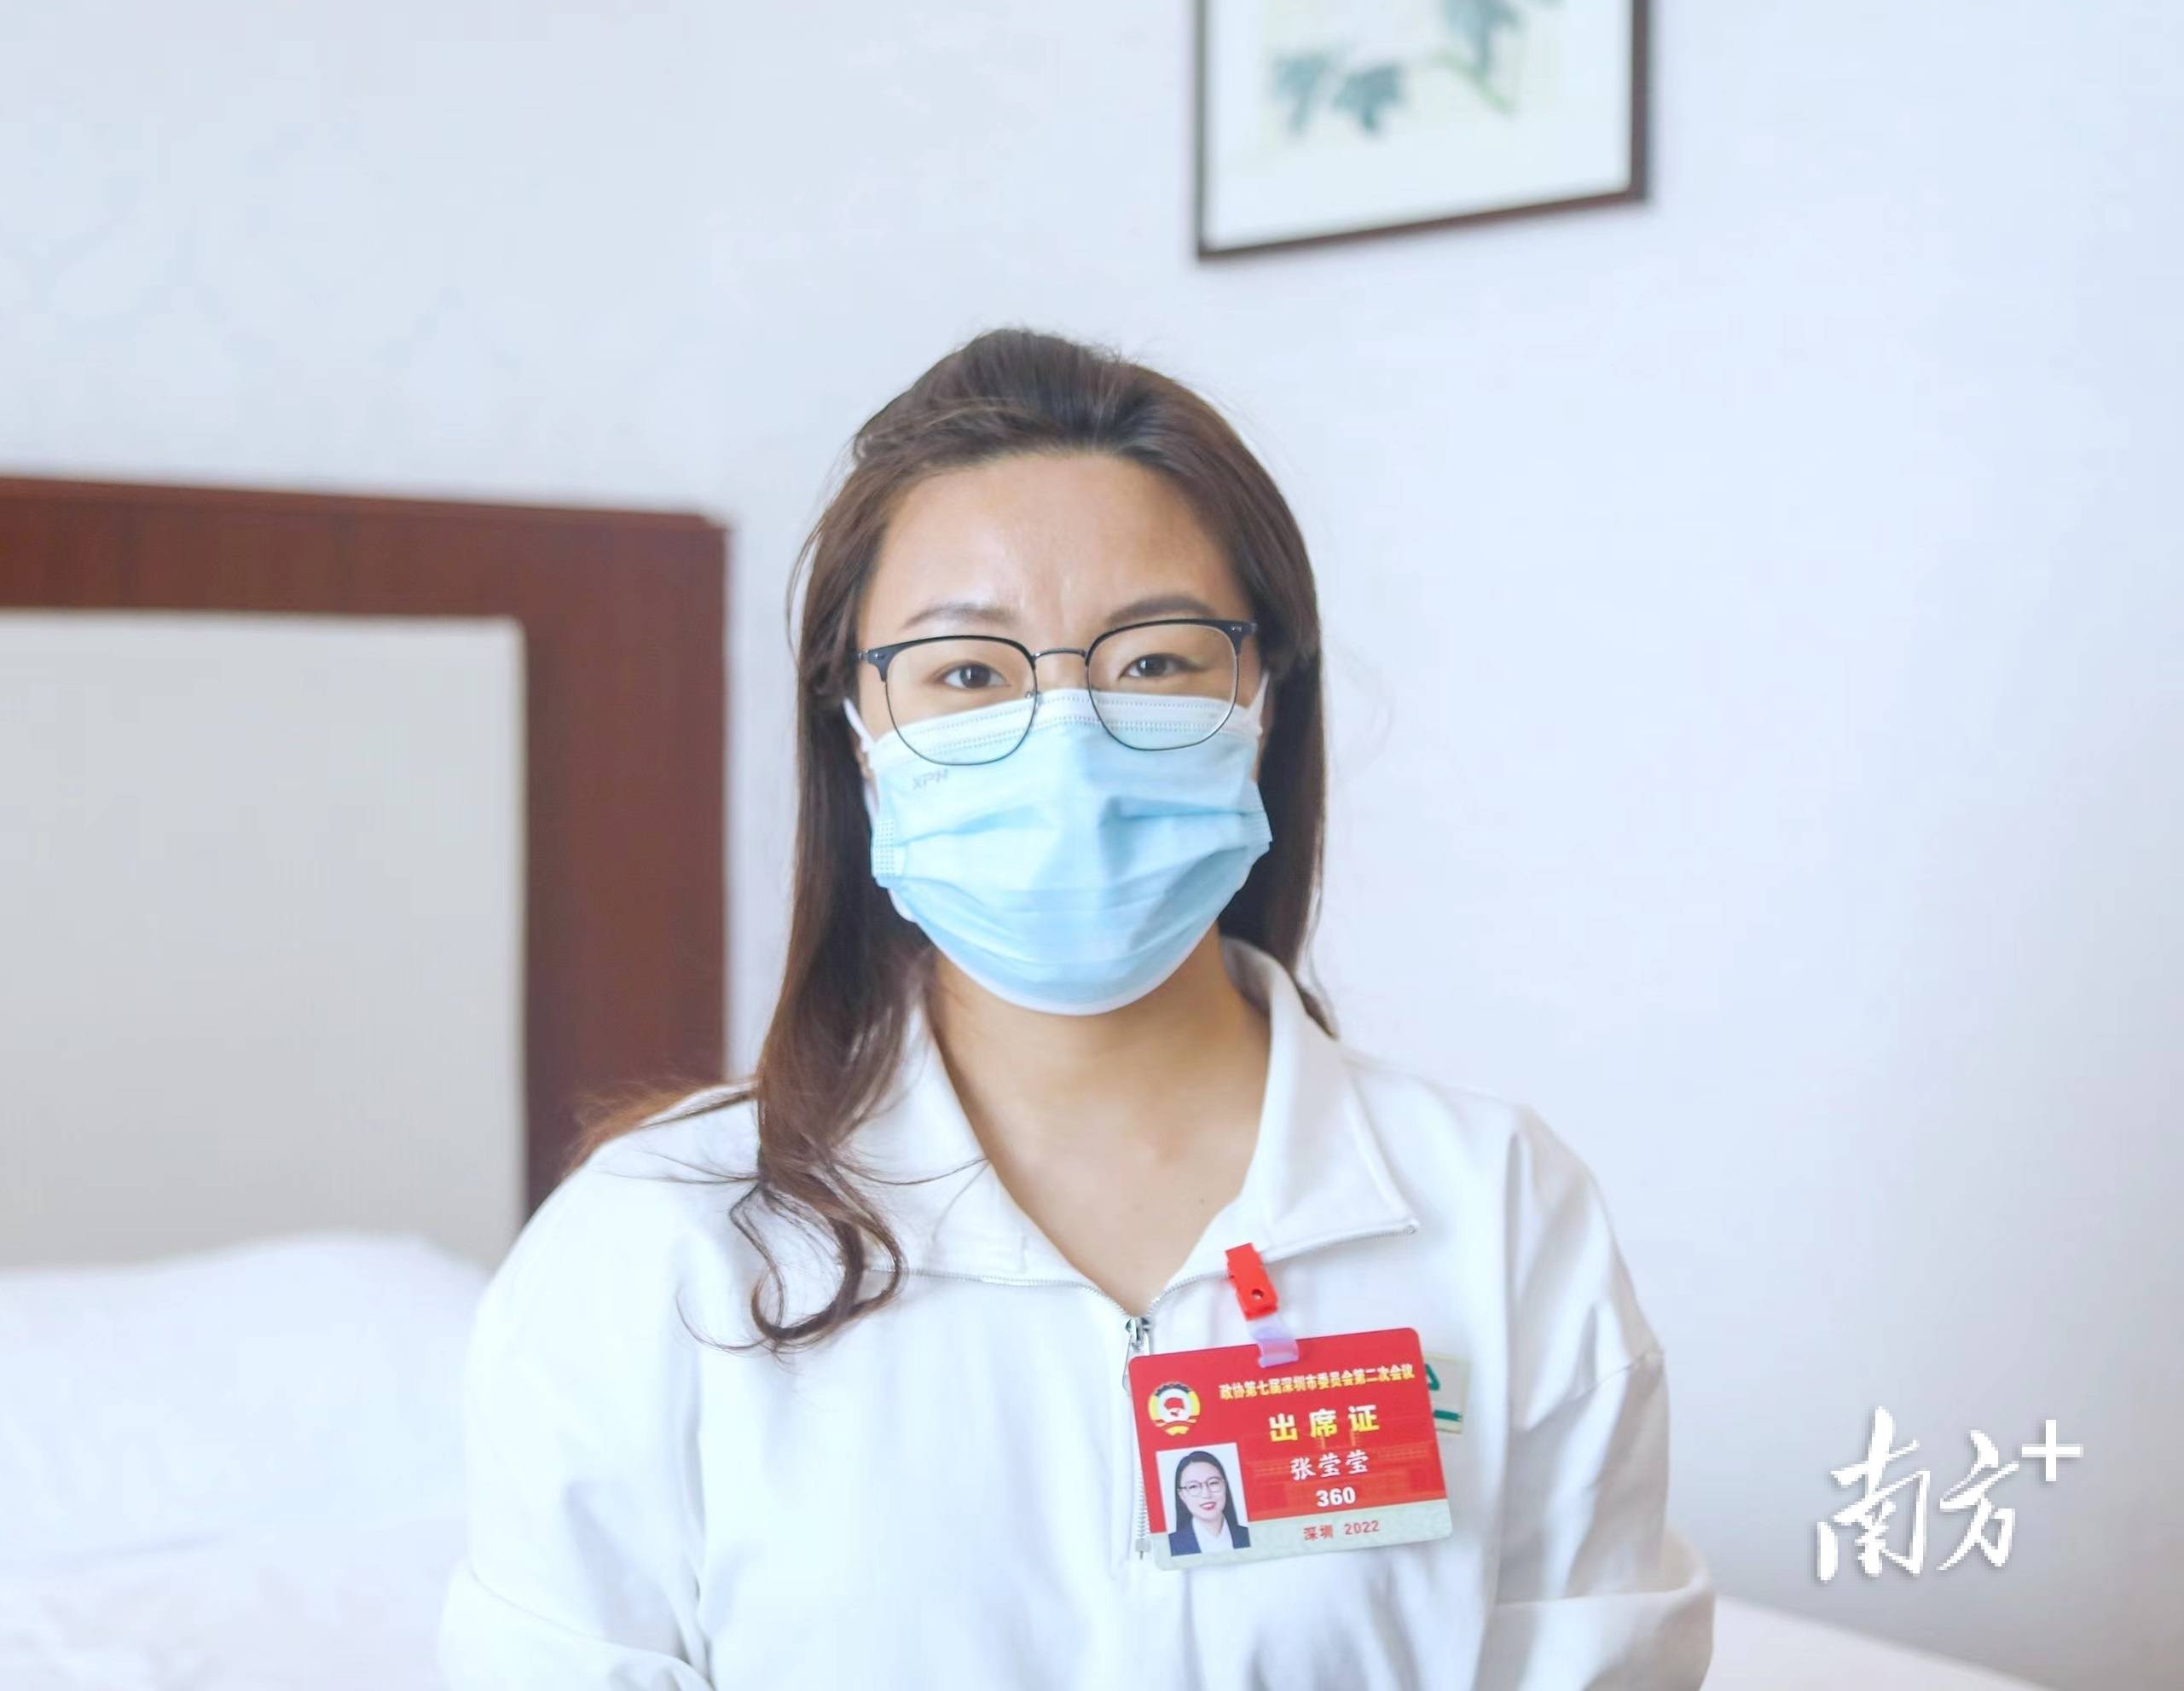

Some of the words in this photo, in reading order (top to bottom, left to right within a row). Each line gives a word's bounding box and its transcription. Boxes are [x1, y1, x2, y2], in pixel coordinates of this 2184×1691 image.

[1219, 1364, 1414, 1399] 政协第七届深圳市委员会第二次会议
[1269, 1404, 1379, 1442] 出席证
[1290, 1451, 1369, 1481] 张莹莹
[1316, 1487, 1356, 1508] 360
[1303, 1526, 1334, 1542] 深圳
[1345, 1520, 1380, 1536] 2022
